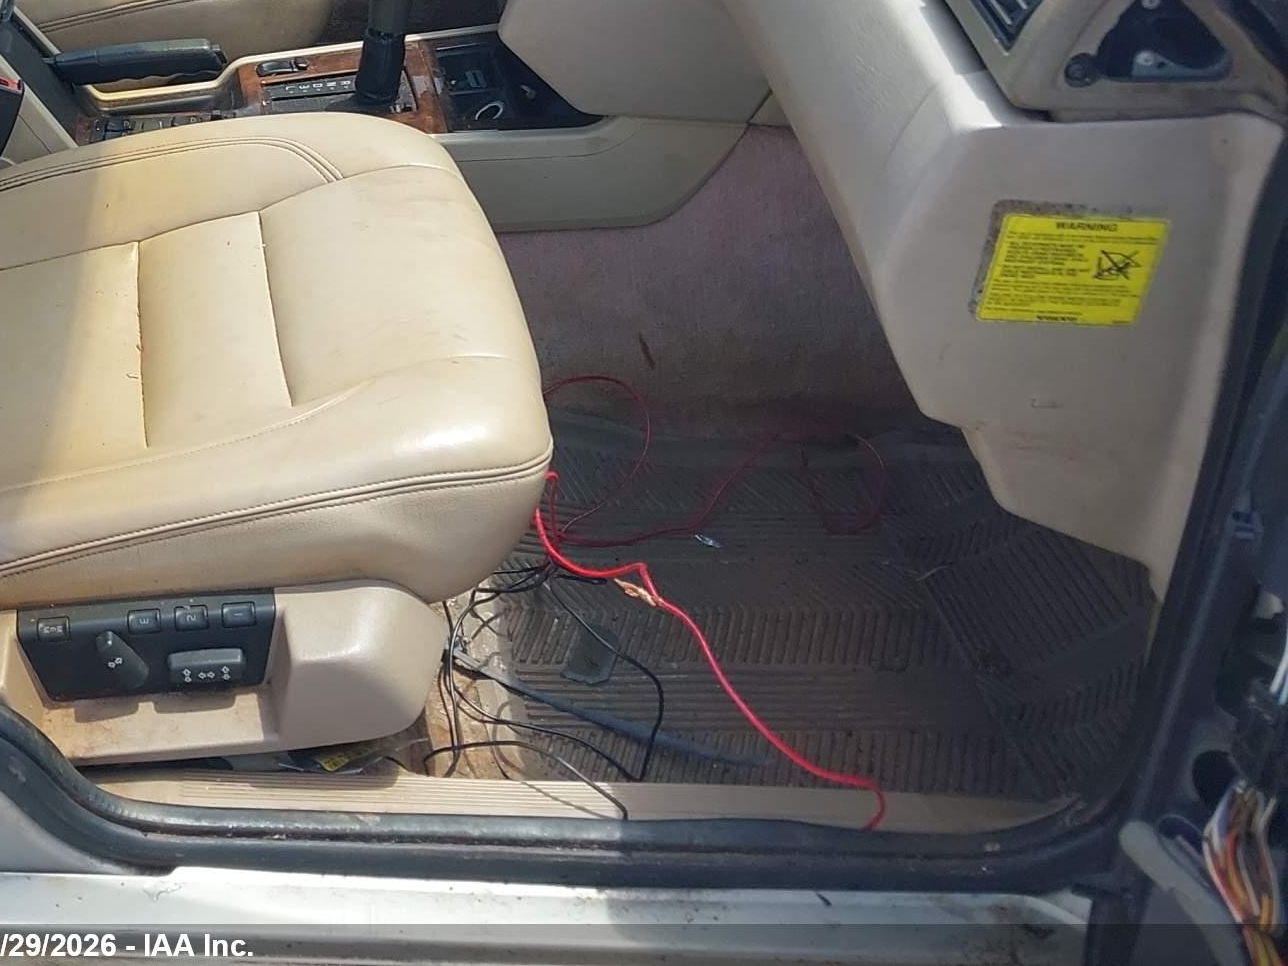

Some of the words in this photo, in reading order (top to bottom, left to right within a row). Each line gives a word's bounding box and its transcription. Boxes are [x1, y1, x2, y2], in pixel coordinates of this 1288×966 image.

[1055, 221, 1118, 232] WARNING
[138, 617, 150, 625] 3
[186, 614, 197, 622] 2
